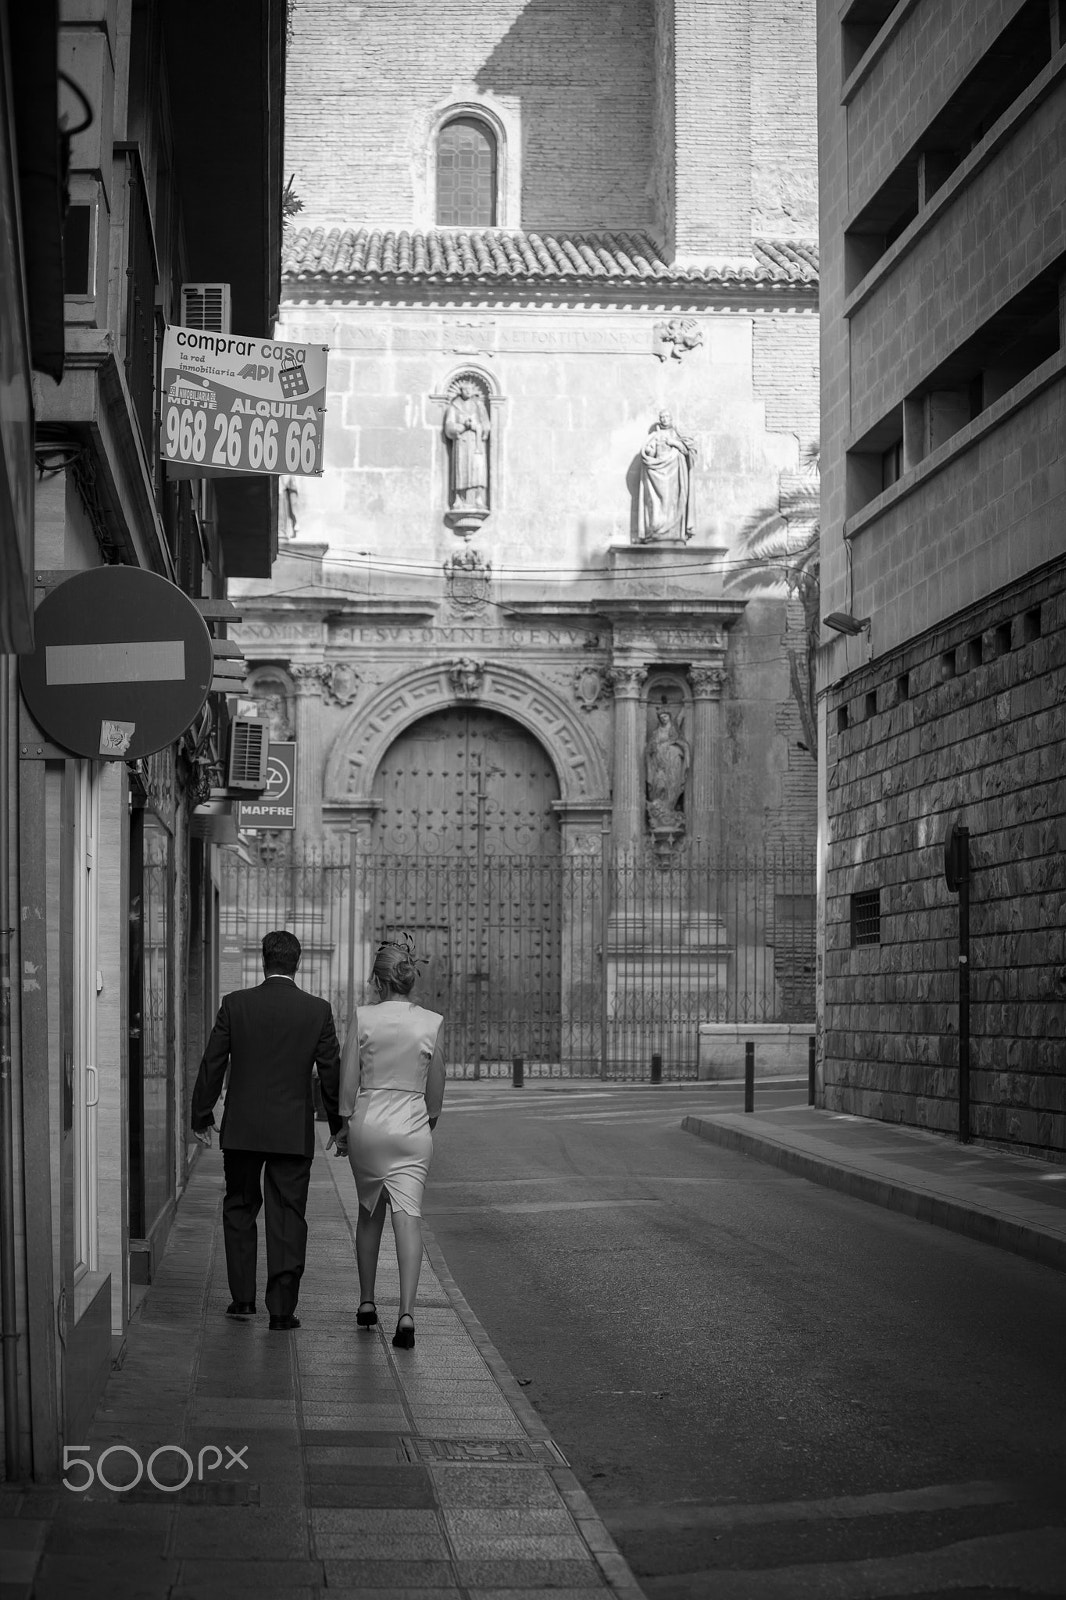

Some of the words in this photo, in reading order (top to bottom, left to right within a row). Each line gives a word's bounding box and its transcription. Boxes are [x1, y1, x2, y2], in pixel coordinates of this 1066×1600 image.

[177, 332, 255, 356] comprar
[261, 344, 306, 363] casa
[180, 353, 188, 361] la
[191, 355, 205, 363] red
[179, 363, 235, 377] inmobiliaria
[237, 363, 274, 383] API
[167, 397, 217, 409] MOTJE
[230, 398, 317, 421] ALQUILA
[166, 406, 207, 462] 968
[211, 413, 243, 467] 26
[248, 417, 279, 471] 66
[285, 421, 316, 474] 66
[421, 628, 493, 644] OMNE
[241, 805, 293, 816] MAPFRE
